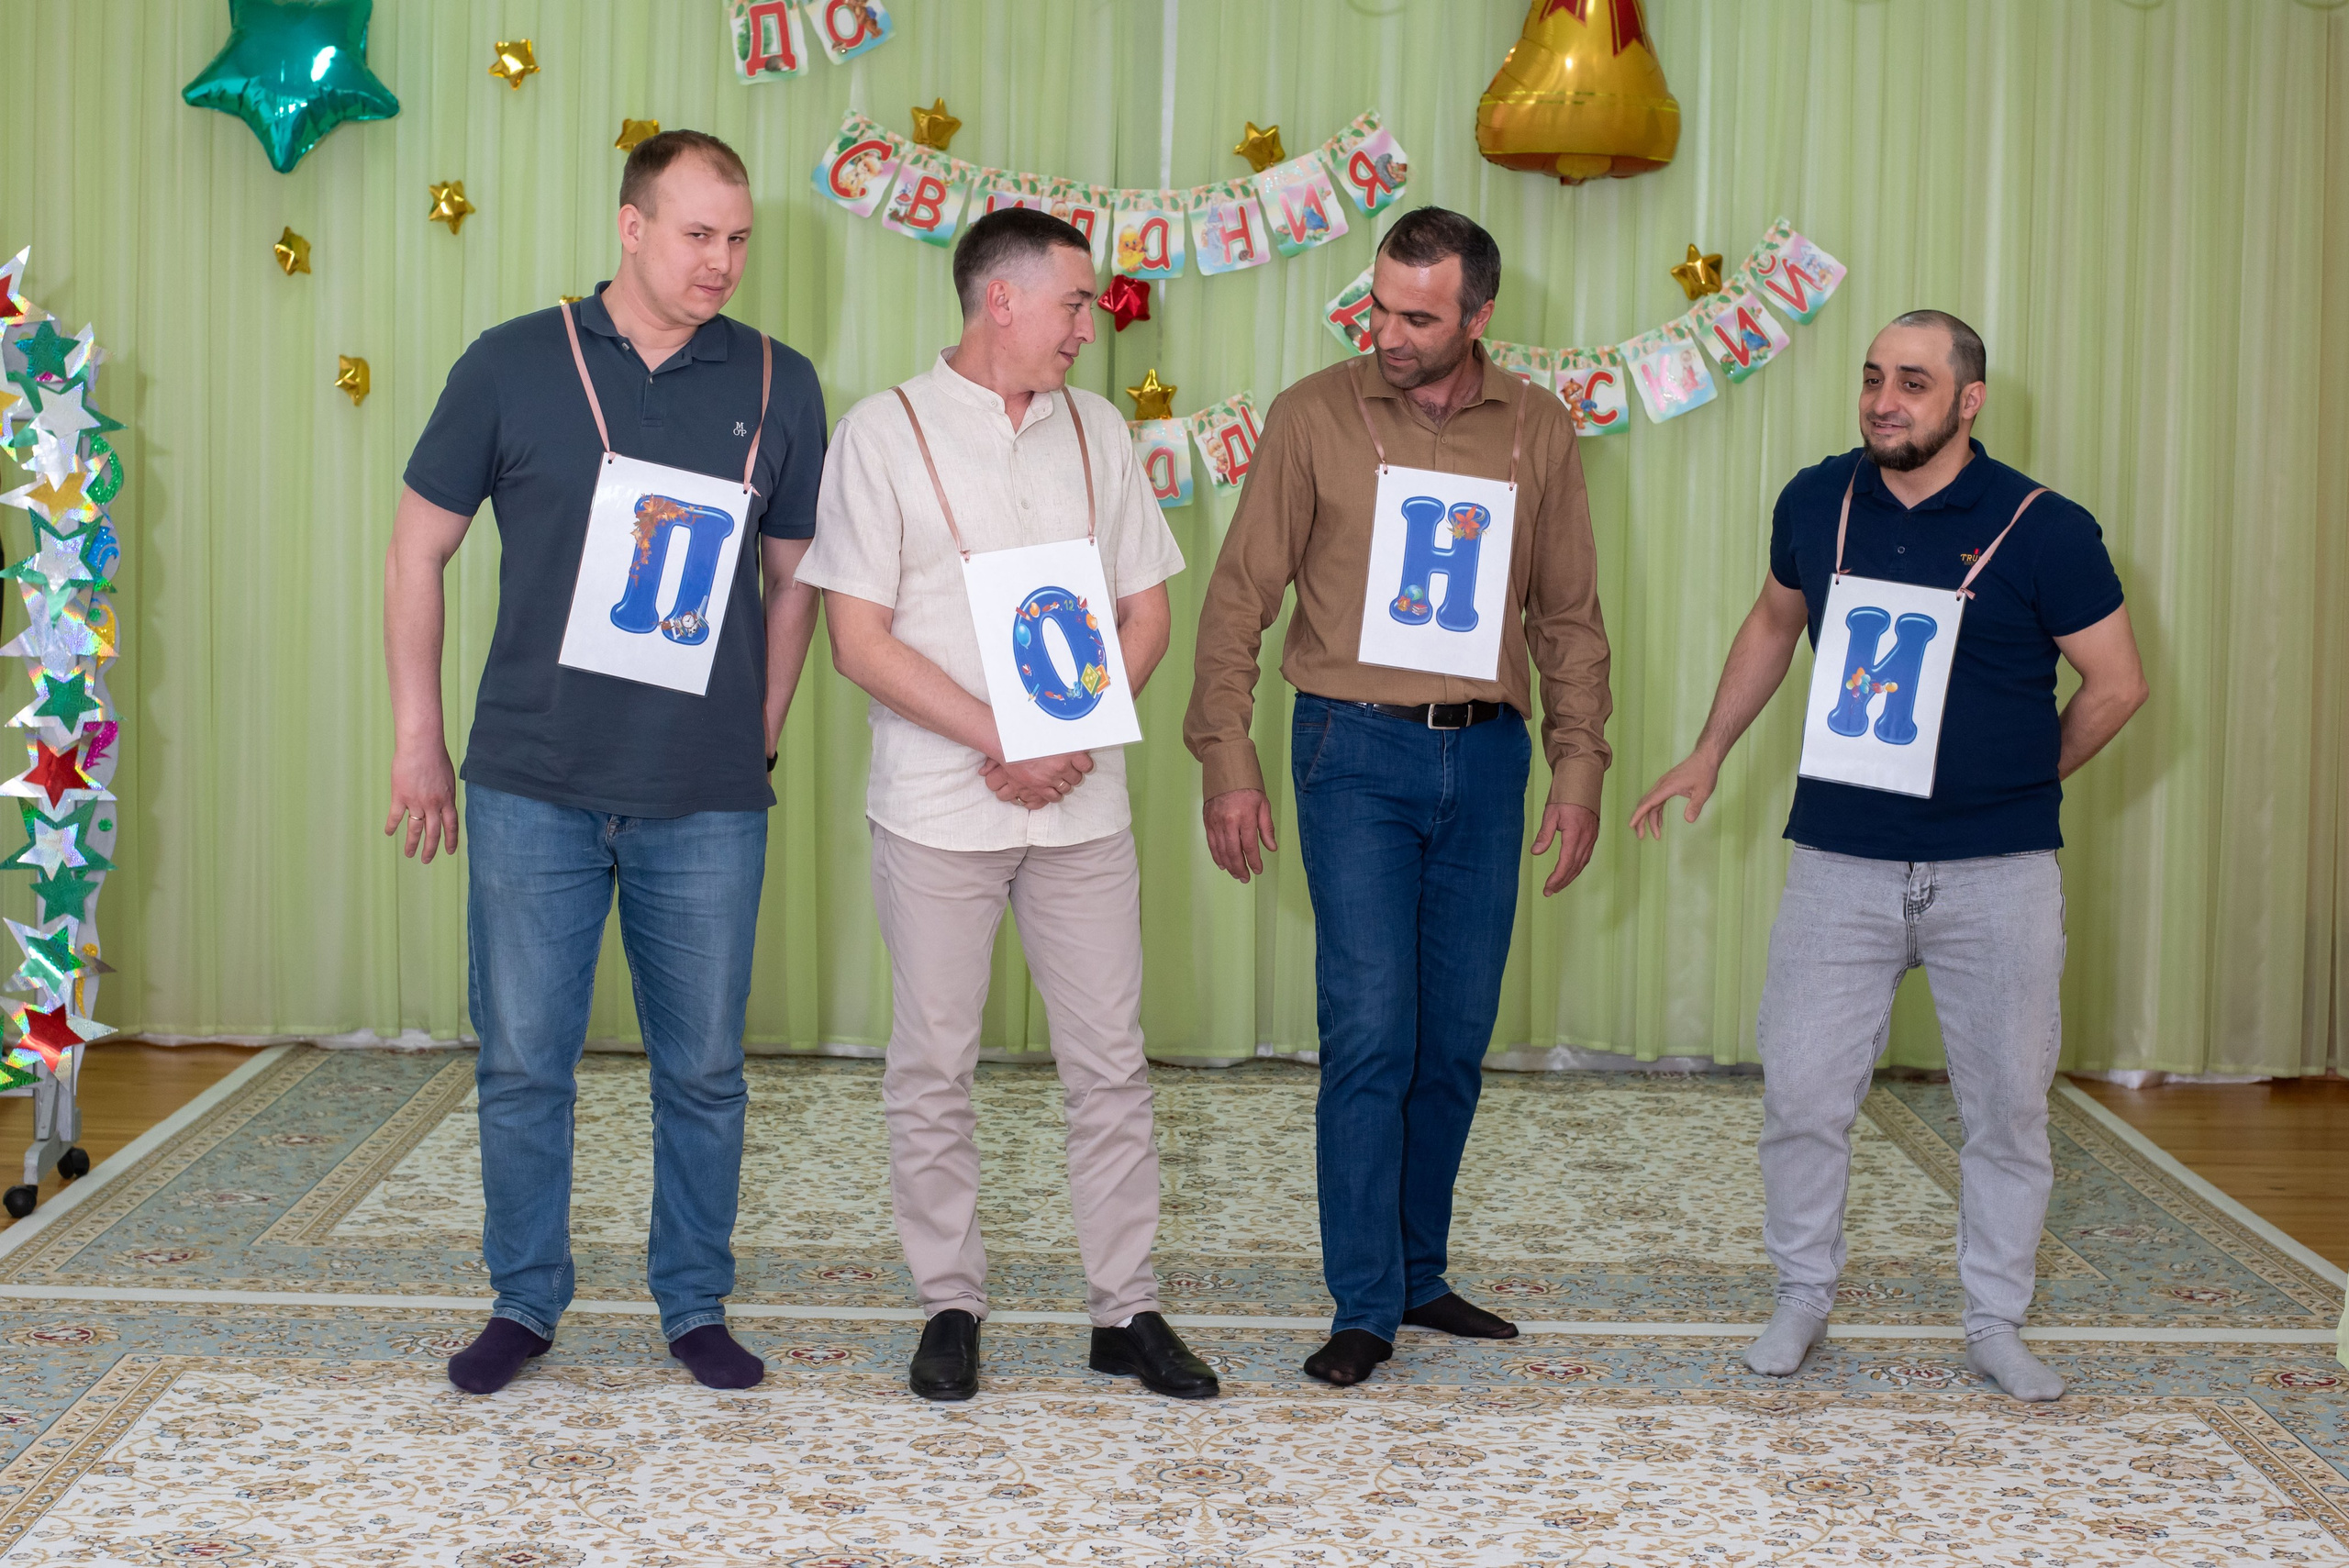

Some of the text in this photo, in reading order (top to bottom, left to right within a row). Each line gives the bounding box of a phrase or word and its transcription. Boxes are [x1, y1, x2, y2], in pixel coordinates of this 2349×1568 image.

[610, 495, 734, 645] П
[1389, 496, 1490, 632] Н
[1013, 586, 1108, 720] О
[1827, 606, 1938, 745] И
